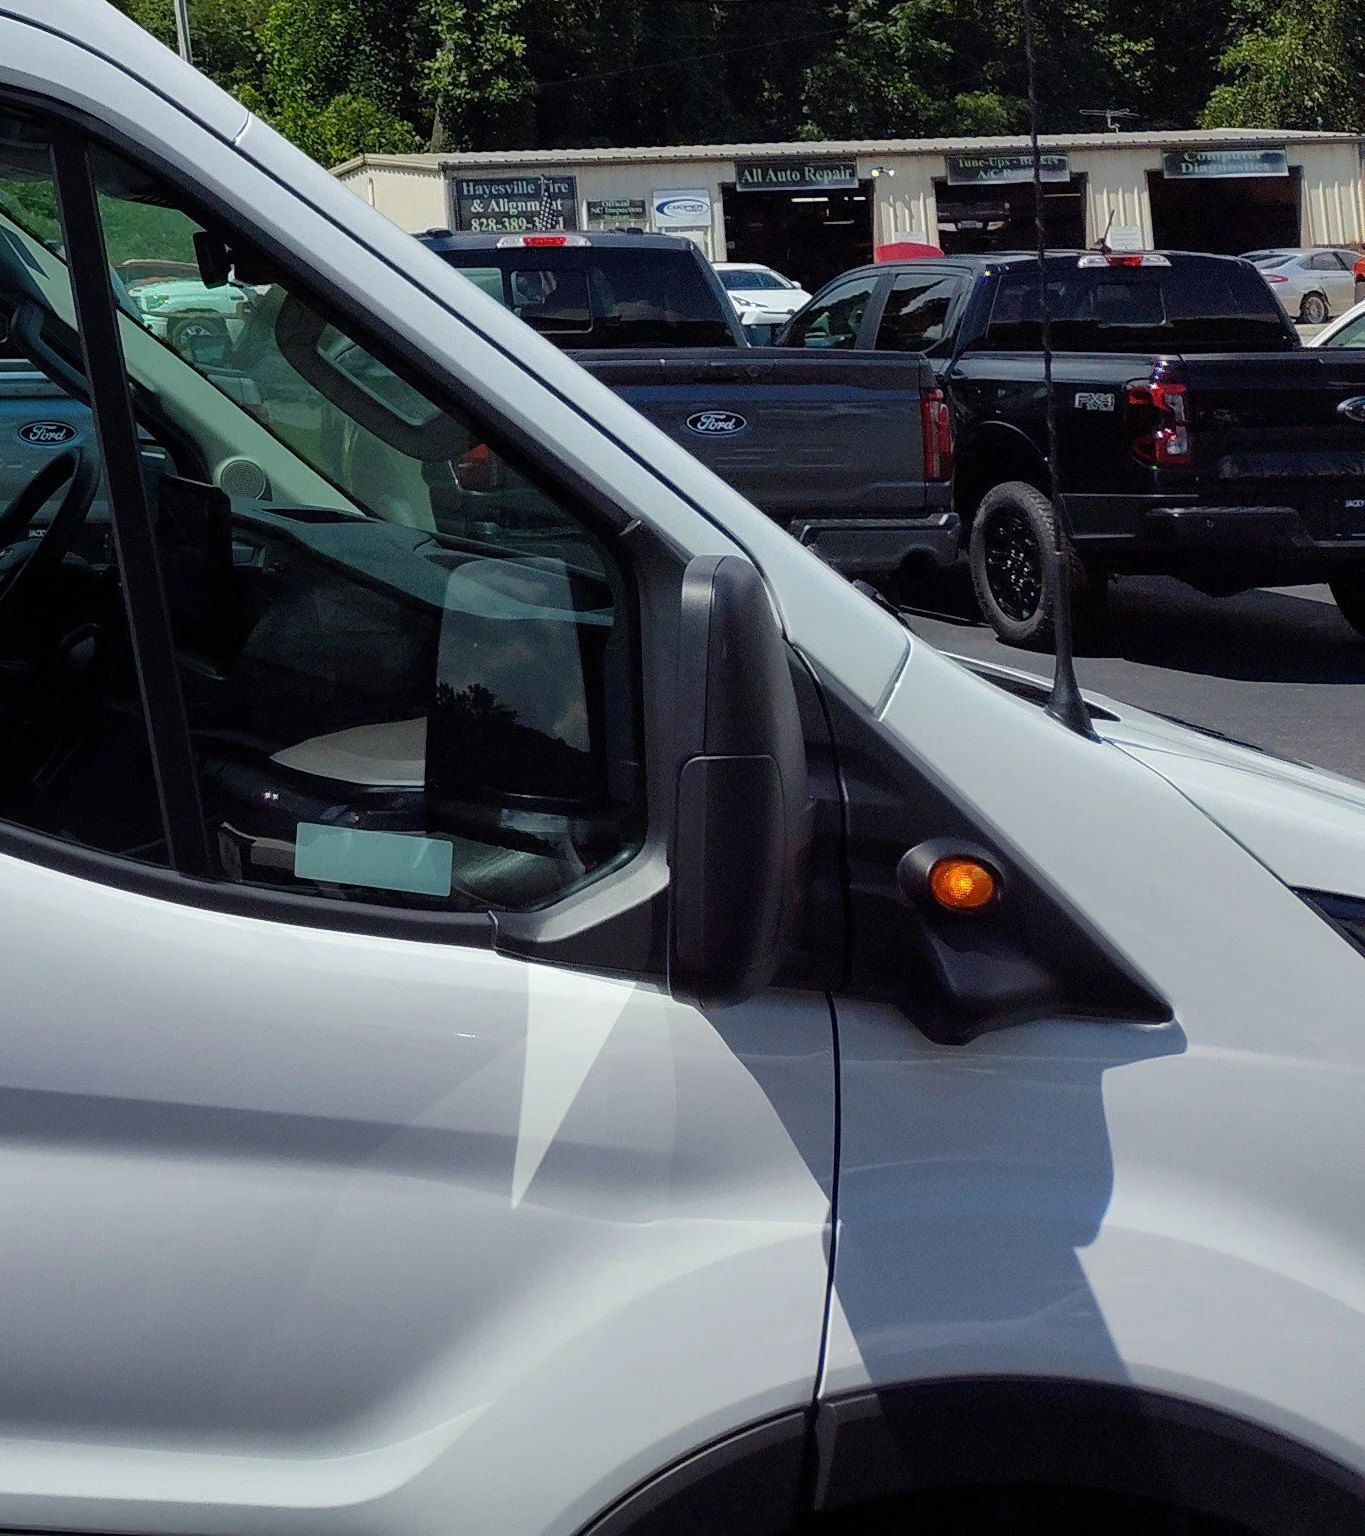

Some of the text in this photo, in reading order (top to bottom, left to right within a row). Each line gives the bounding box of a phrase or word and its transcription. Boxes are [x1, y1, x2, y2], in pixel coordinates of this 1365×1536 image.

[741, 166, 853, 183] All Auto Repair
[1181, 162, 1270, 174] Diagnostics
[462, 180, 536, 198] Hayesville
[470, 197, 563, 215] & Alignmt
[471, 216, 565, 231] 828-389-31
[1074, 393, 1114, 411] FX4
[697, 414, 736, 431] Ford
[29, 425, 67, 441] Ford
